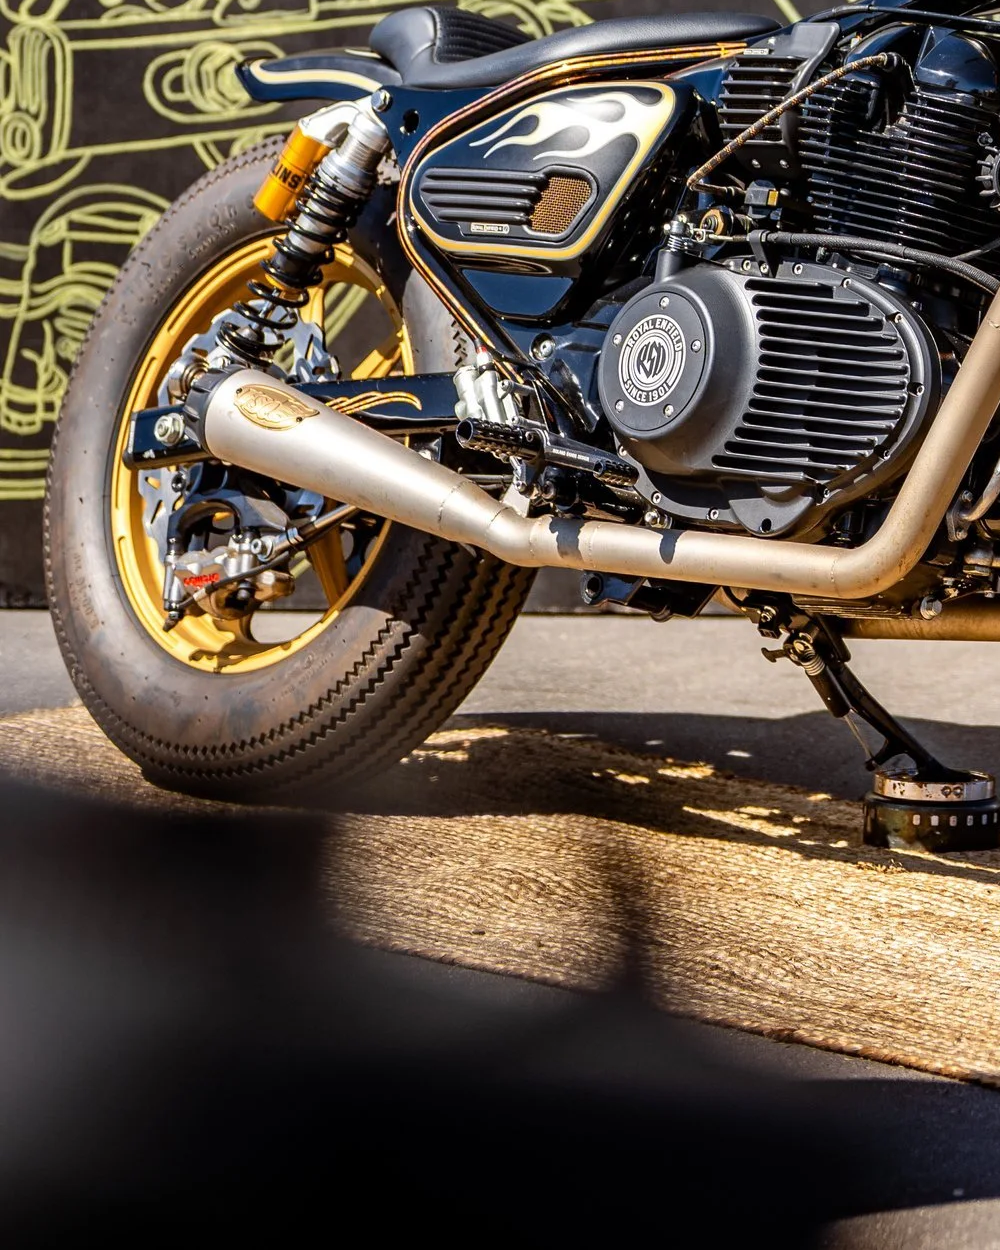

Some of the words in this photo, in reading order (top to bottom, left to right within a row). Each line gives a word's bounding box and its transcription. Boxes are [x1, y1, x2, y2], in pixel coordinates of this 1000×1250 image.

[627, 319, 654, 348] ROYAL
[655, 318, 683, 353] ENFIELD
[624, 379, 647, 402] SINCE
[648, 382, 670, 402] 1901
